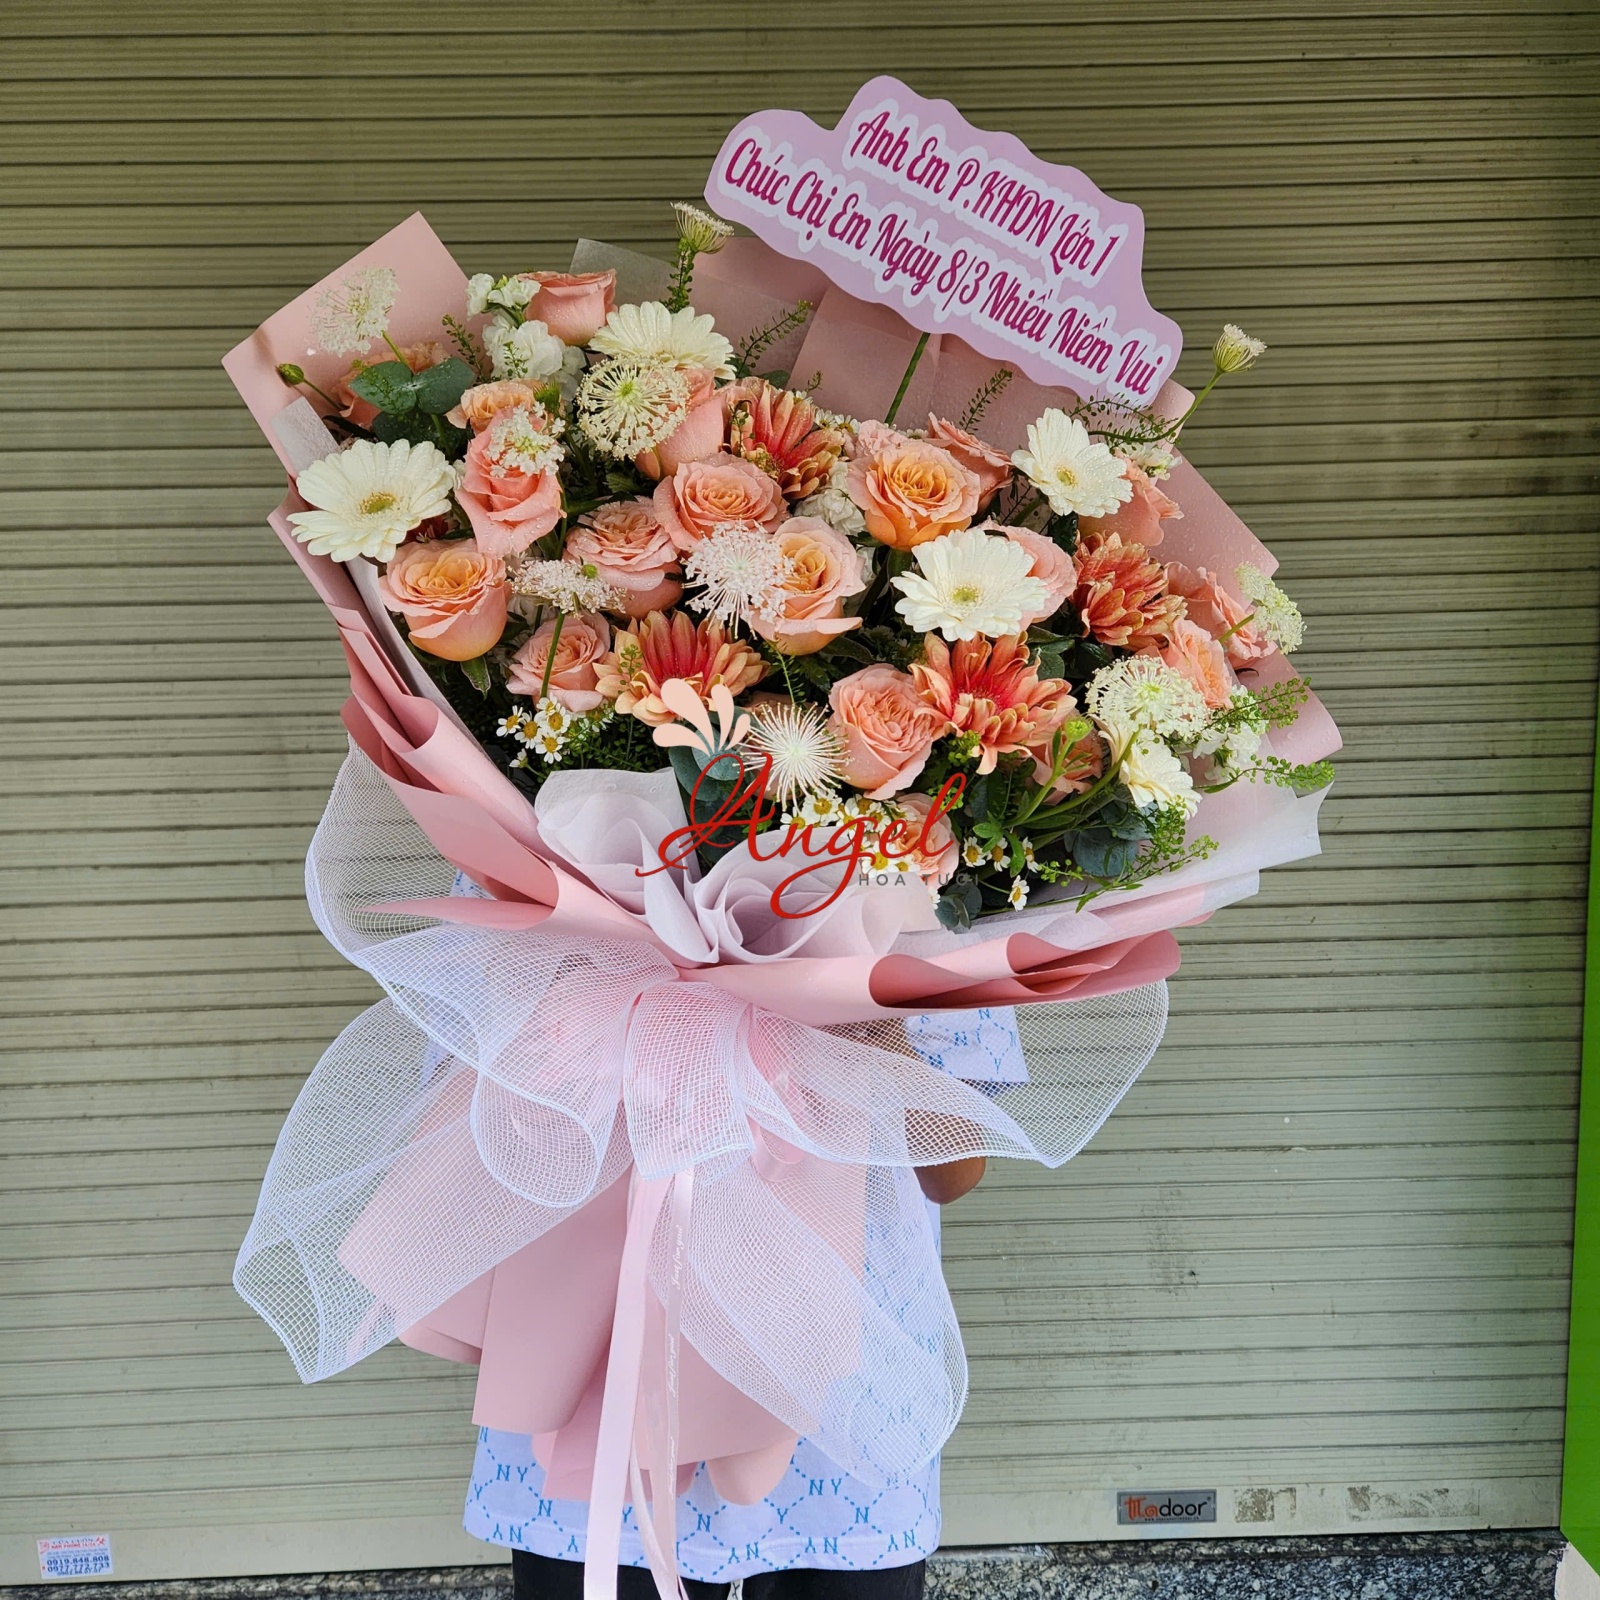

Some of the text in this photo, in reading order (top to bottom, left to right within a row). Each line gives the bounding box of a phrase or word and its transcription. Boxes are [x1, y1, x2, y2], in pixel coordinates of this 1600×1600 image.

[725, 138, 790, 206] Chúc
[786, 170, 838, 241] Chị
[828, 192, 872, 250] Em
[869, 213, 942, 296] Ngày
[936, 249, 991, 312] 8/3
[1114, 339, 1163, 395] Vui
[849, 111, 1120, 277] Anh Em P.KHDN Lớn 1
[809, 1478, 842, 1496] NY
